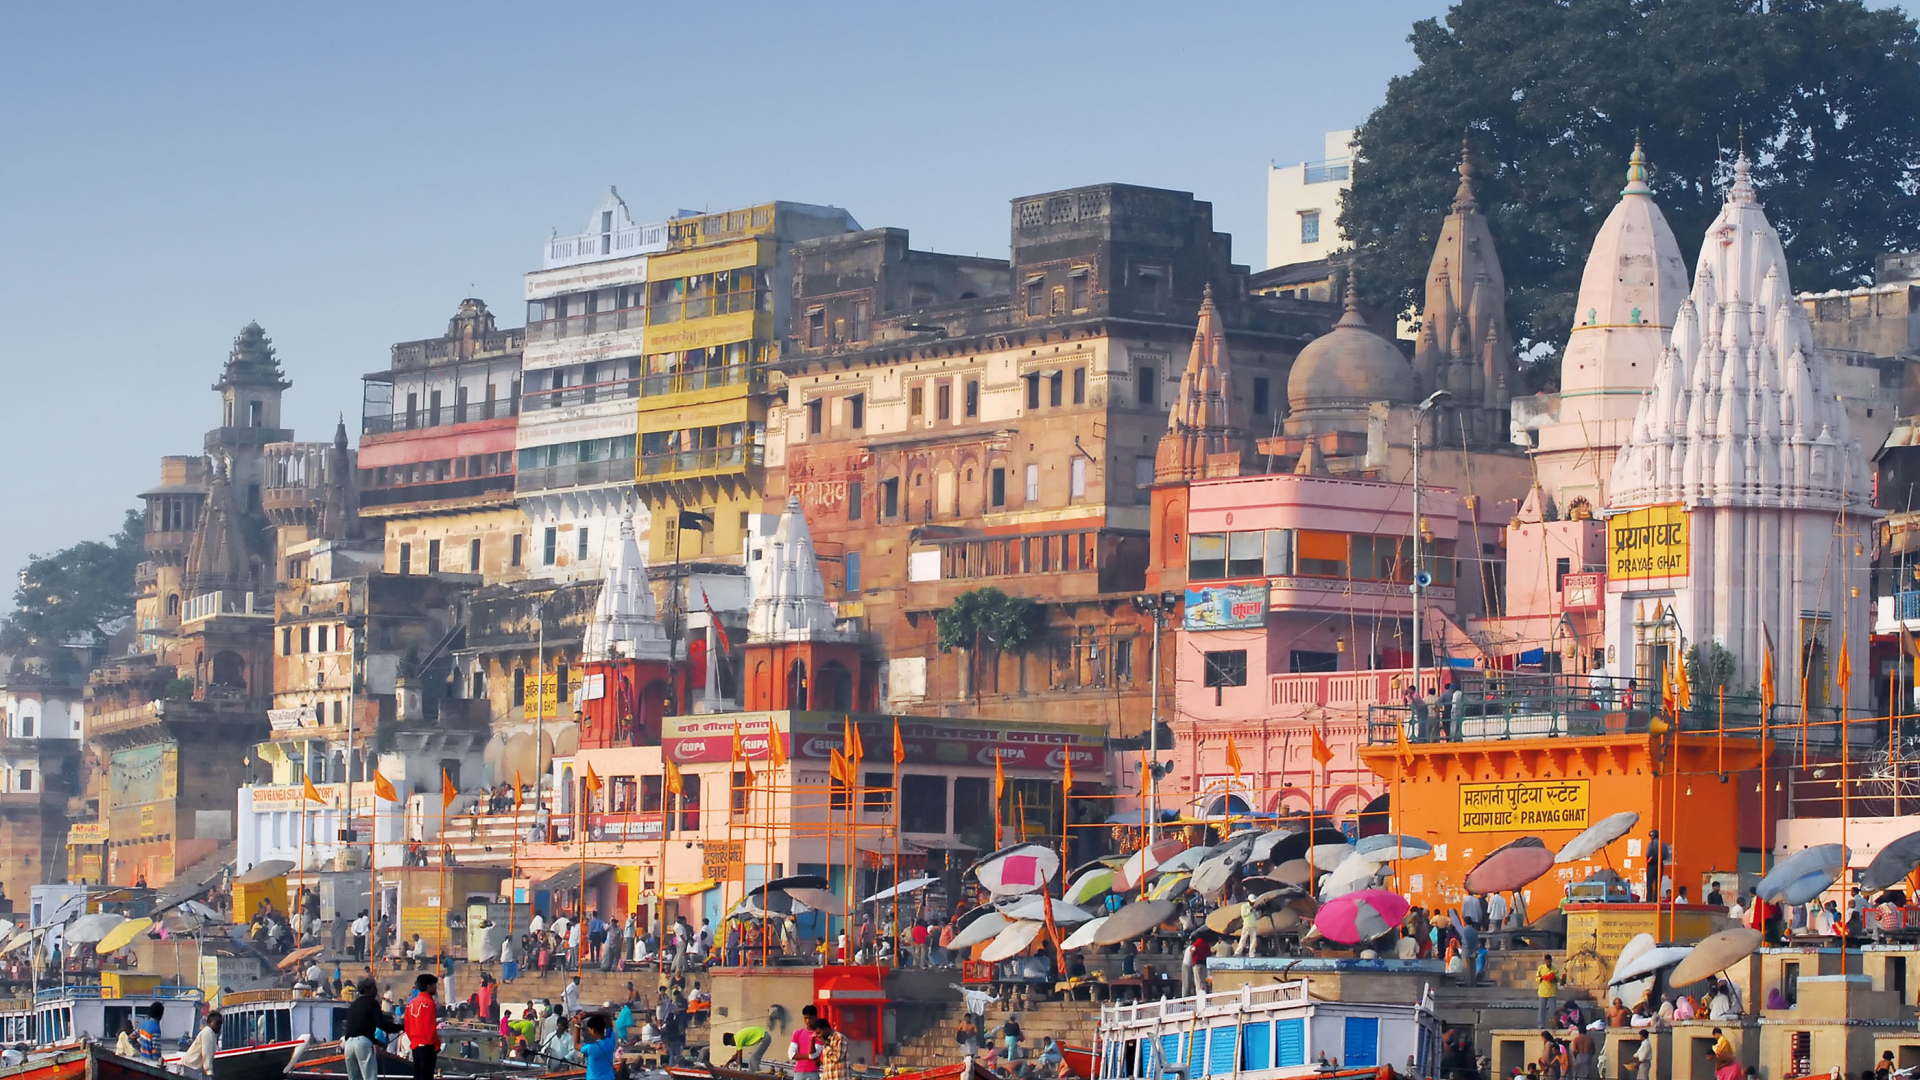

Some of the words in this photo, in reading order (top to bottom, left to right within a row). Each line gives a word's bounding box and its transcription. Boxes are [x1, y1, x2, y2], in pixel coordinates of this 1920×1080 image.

[1615, 525, 1656, 554] प्रयाग
[1657, 523, 1682, 546] घाट
[1617, 556, 1654, 573] PRAYAG
[1657, 554, 1682, 569] GHAT
[1232, 601, 1263, 620] झूला
[745, 720, 772, 730] मात
[681, 741, 706, 752] RUPA
[744, 739, 768, 750] RUPA
[814, 739, 844, 751] RUP
[988, 747, 1026, 759] RUPA
[1056, 750, 1094, 761] RUPA
[287, 788, 304, 800] SILK
[1506, 783, 1544, 810] पुटिया
[1547, 781, 1581, 804] स्टेट
[1463, 811, 1493, 827] प्रयाग
[1494, 811, 1513, 826] घाट
[1521, 809, 1560, 824] PRAYAG
[1562, 808, 1586, 822] GHAT
[708, 865, 727, 878] घाट
